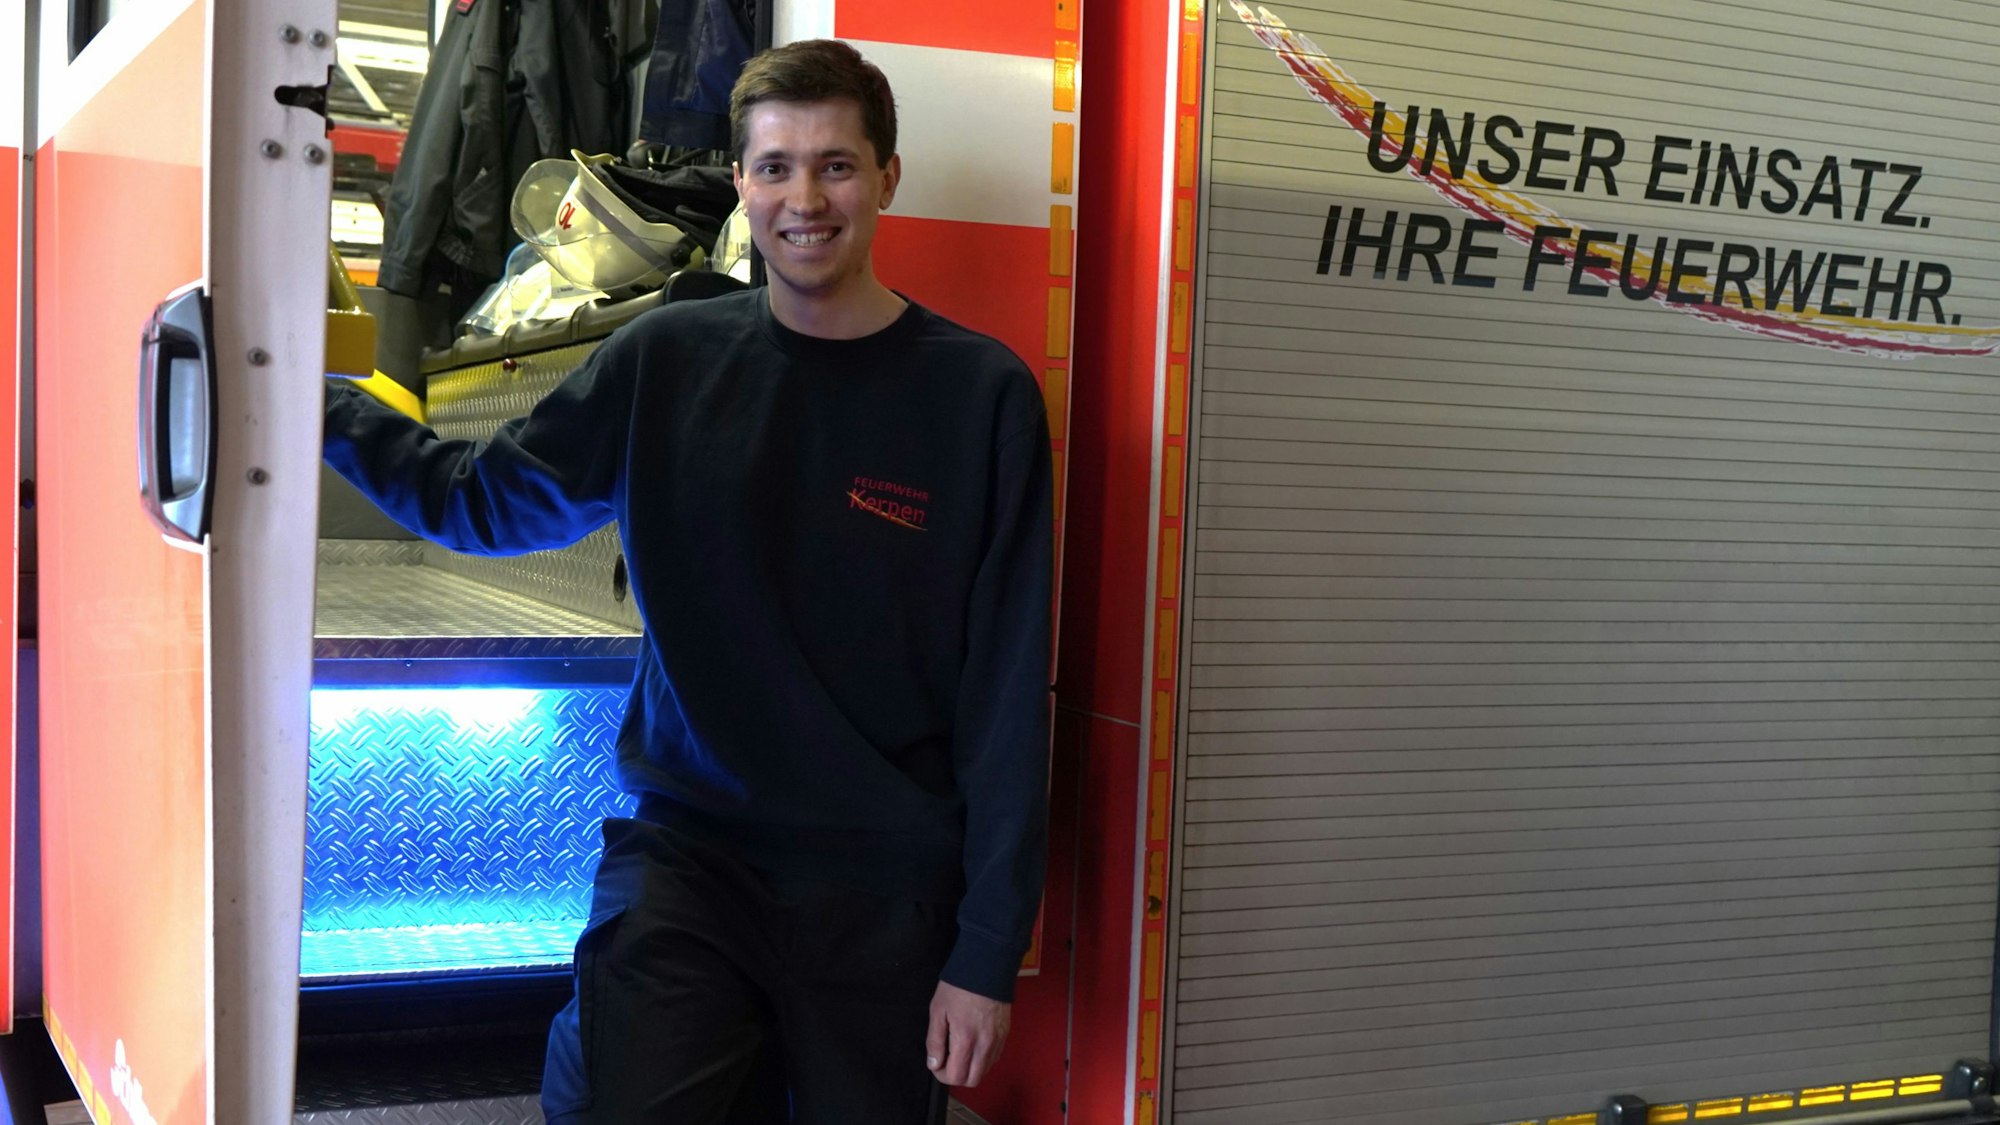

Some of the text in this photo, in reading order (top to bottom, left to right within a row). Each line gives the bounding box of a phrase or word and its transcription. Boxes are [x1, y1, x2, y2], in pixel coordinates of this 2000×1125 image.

[1367, 101, 1931, 229] UNSER EINSATZ.
[1316, 205, 1962, 326] IHRE FEUERWEHR.
[849, 488, 927, 524] Kerpen
[853, 476, 930, 502] FEUERWEHR
